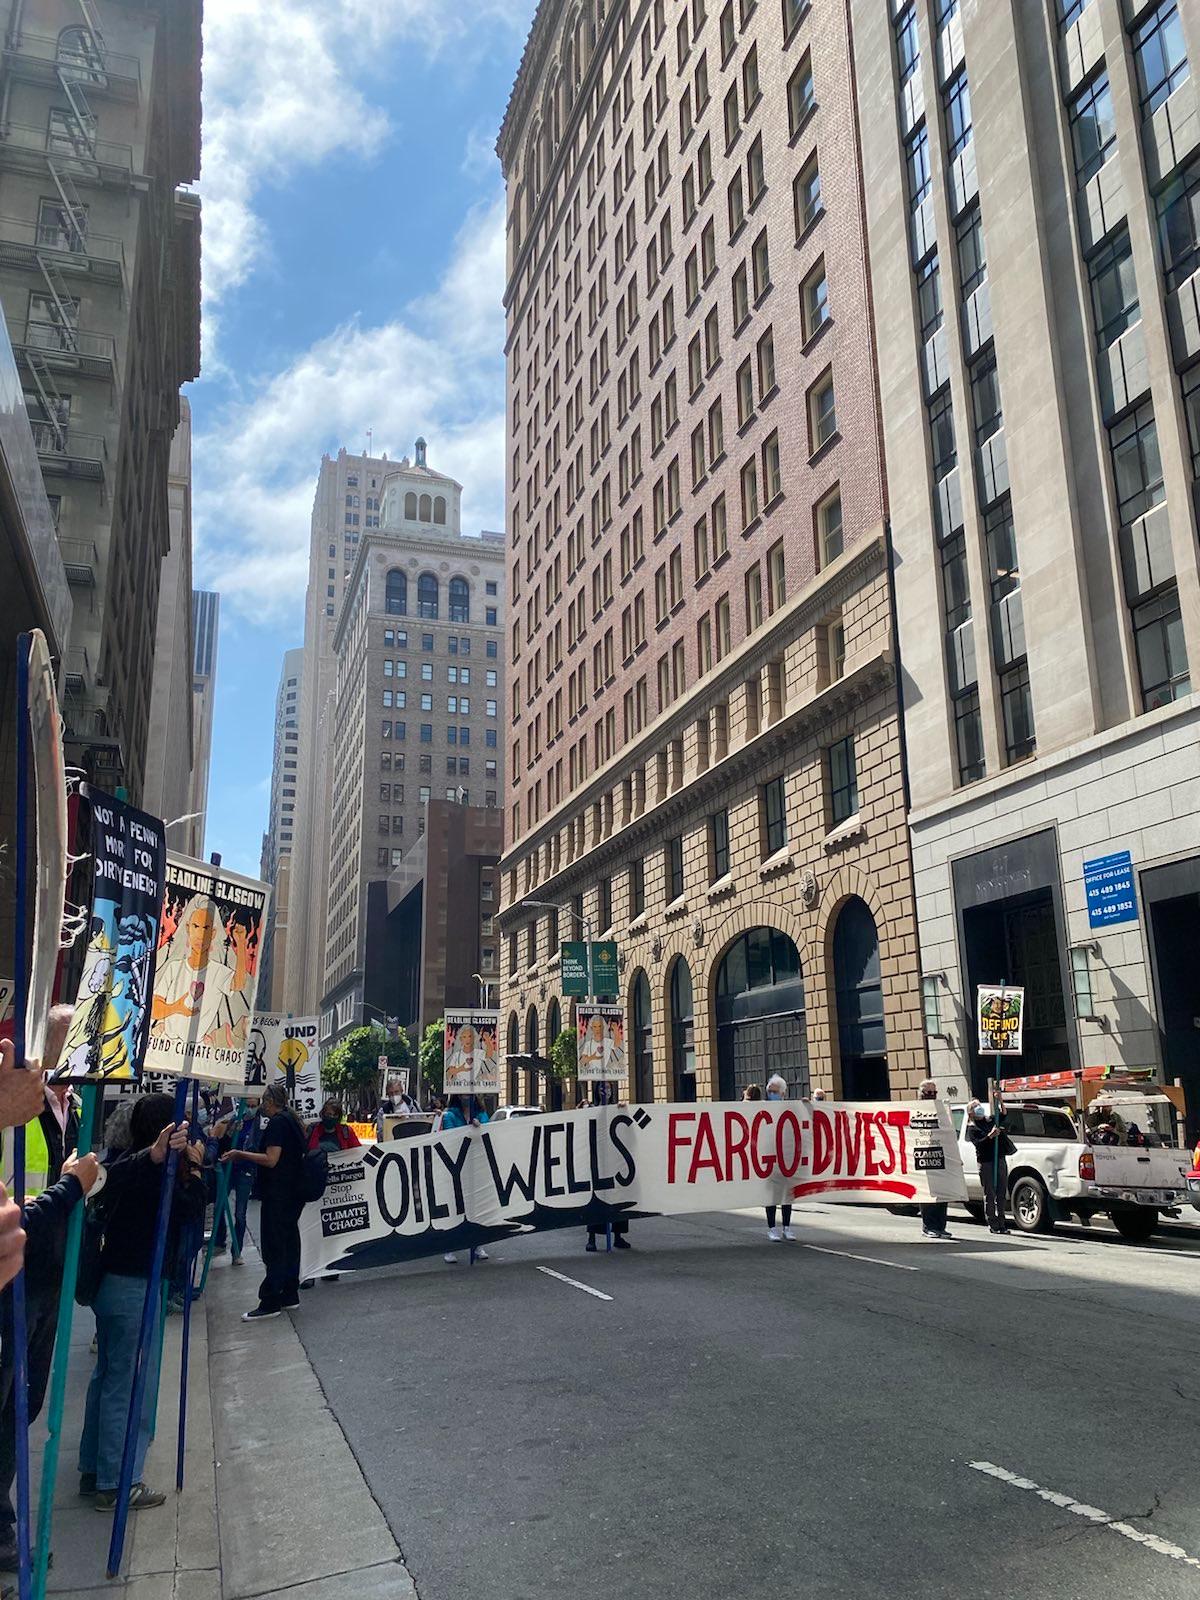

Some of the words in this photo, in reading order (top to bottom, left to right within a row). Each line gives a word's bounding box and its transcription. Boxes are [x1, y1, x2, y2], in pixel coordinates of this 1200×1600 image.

[94, 805, 114, 827] NOT
[120, 816, 126, 833] A
[130, 821, 158, 849] PENNY
[1086, 874, 1102, 884] OFFICE
[1114, 867, 1130, 876] LEASE
[165, 866, 214, 895] DEADLINE
[215, 881, 264, 910] GLASGOW
[1089, 889, 1099, 897] 415
[1091, 907, 1102, 916] 415
[175, 1042, 211, 1059] CLIMATE
[215, 1049, 242, 1066] CHAOS
[305, 1098, 316, 1110] 3
[919, 1159, 942, 1167] CHAOS
[331, 1184, 352, 1193] Stop
[323, 1193, 364, 1206] Funding
[322, 1206, 367, 1222] CLIMATE
[329, 1217, 364, 1231] CHAOS
